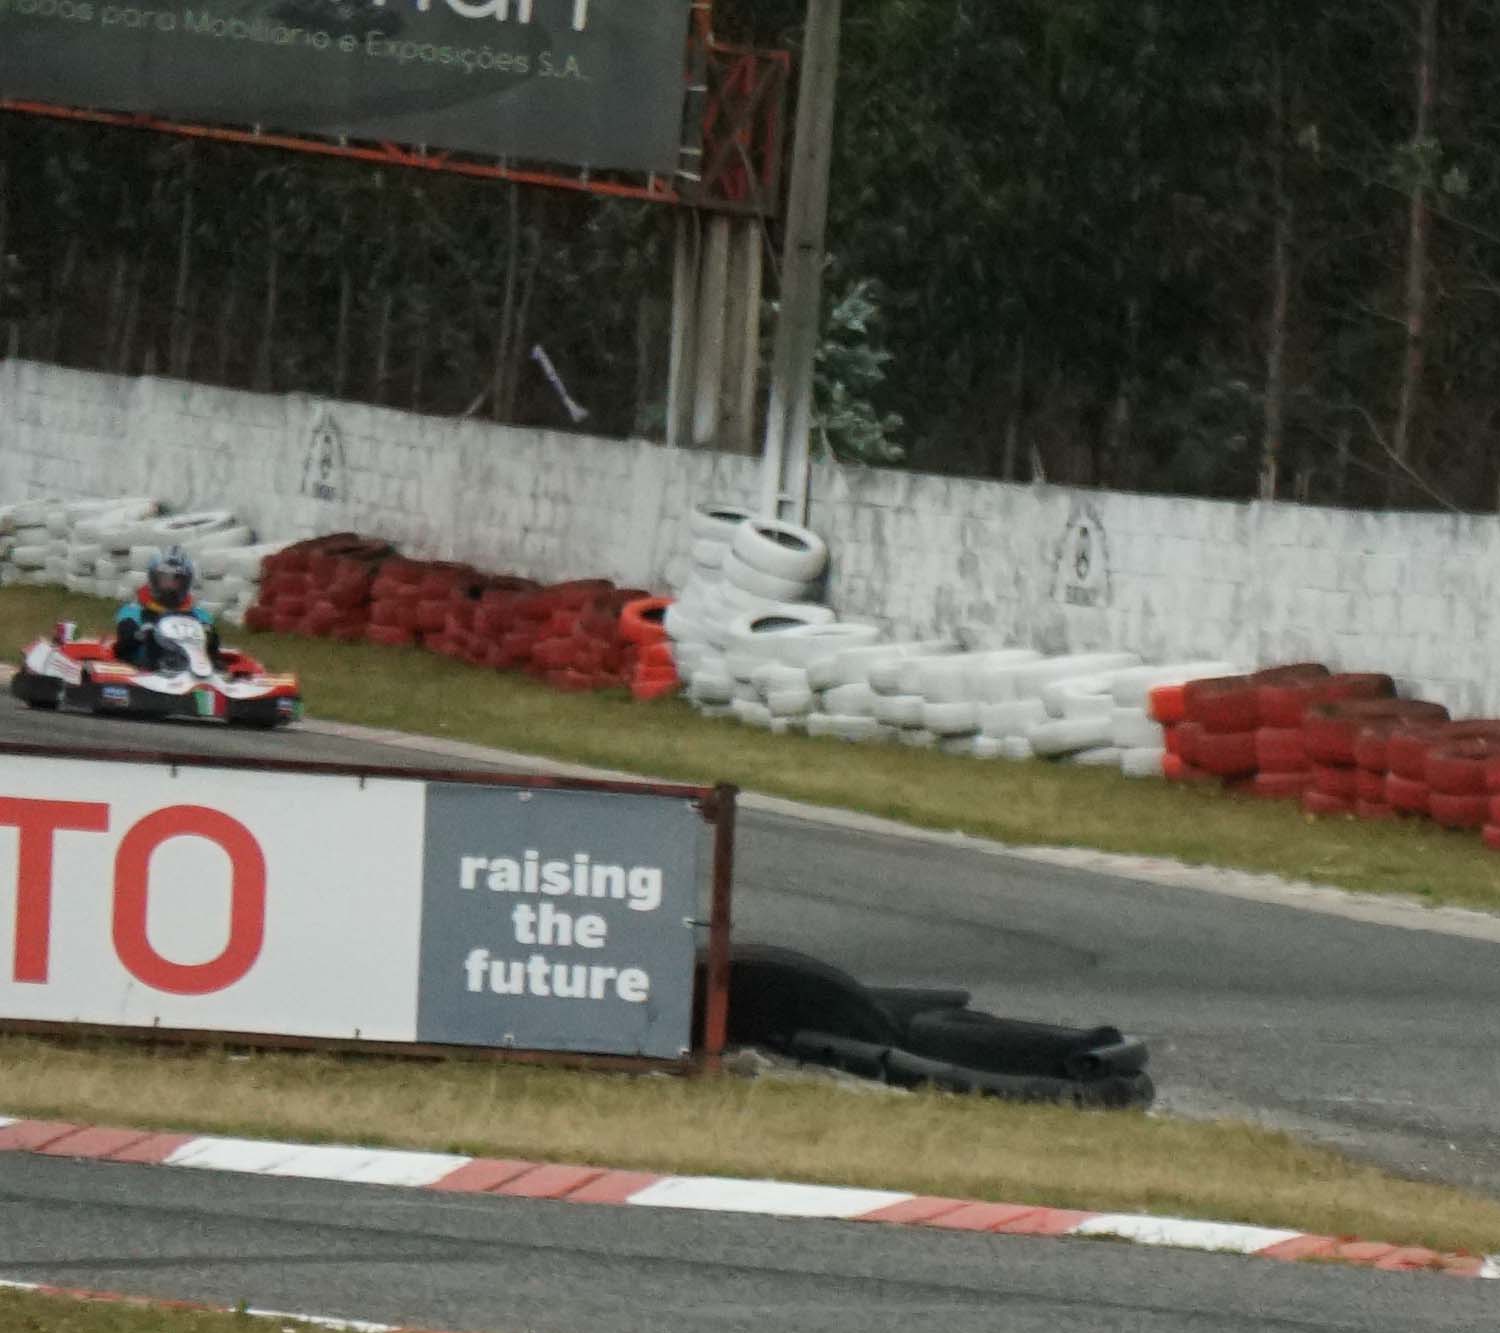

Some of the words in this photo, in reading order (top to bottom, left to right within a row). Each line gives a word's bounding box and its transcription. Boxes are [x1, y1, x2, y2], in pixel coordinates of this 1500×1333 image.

[459, 850, 663, 912] raising
[513, 902, 609, 948] the
[464, 948, 651, 1003] future
